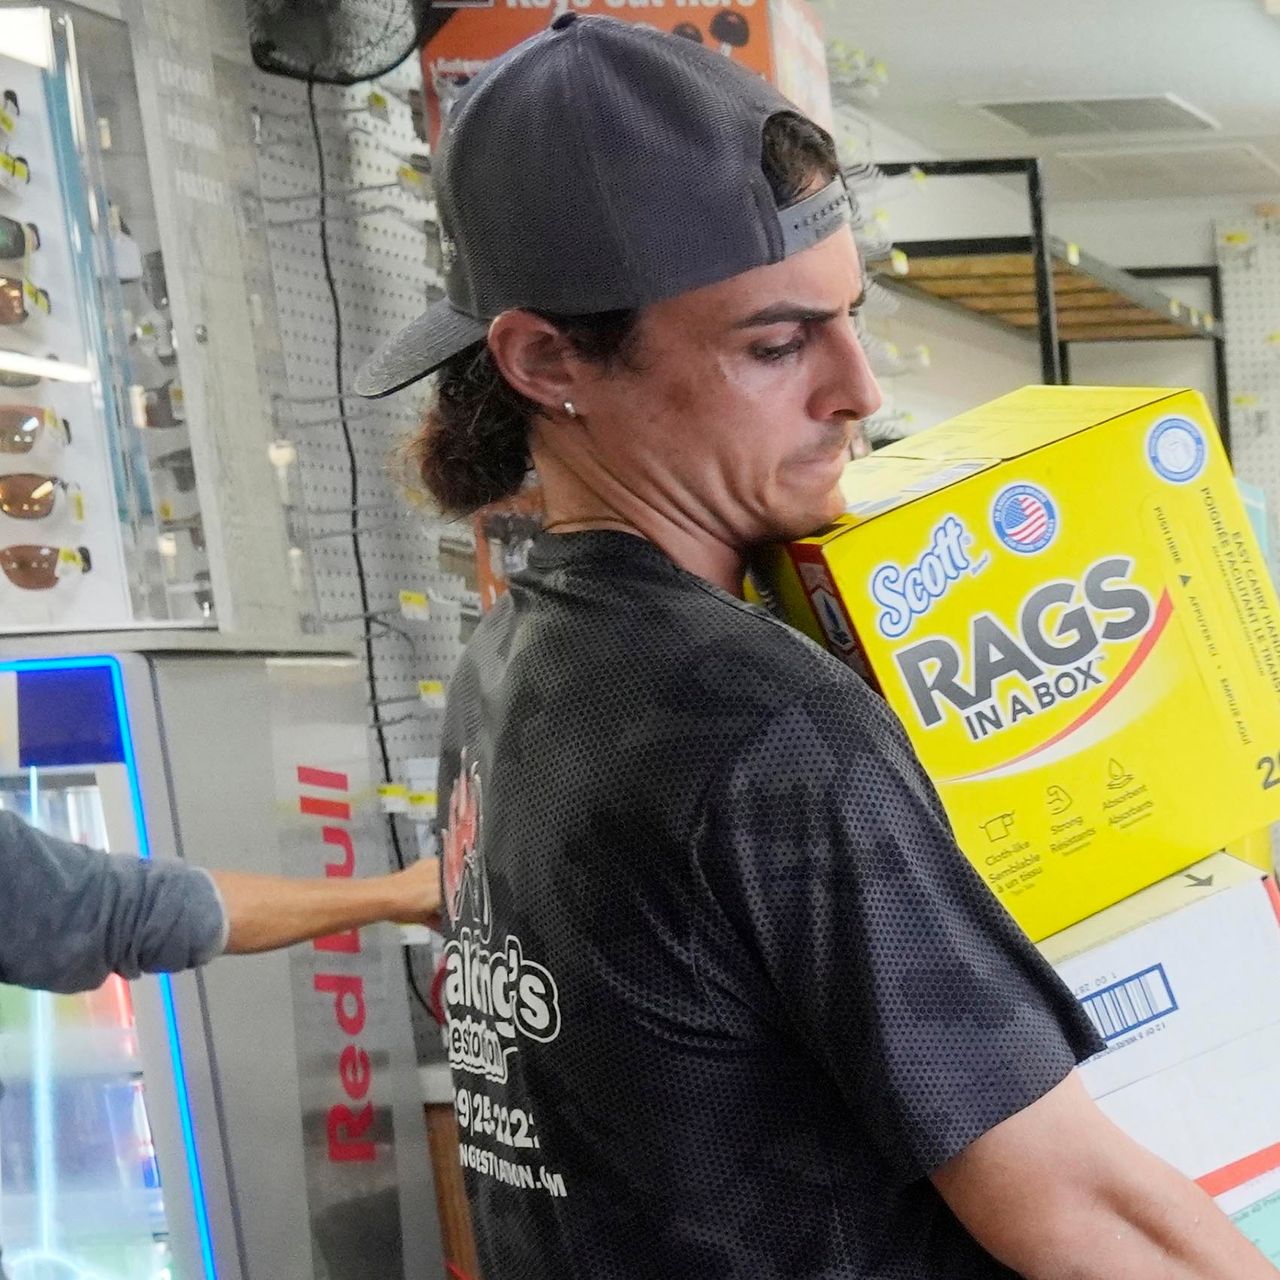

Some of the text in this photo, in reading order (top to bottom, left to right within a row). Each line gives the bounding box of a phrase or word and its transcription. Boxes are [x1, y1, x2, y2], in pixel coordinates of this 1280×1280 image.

[873, 516, 970, 638] Scott
[896, 559, 1151, 728] RAGS
[964, 660, 1102, 741] IN A BOX
[1050, 816, 1084, 835] Strong
[326, 971, 378, 1163] Red
